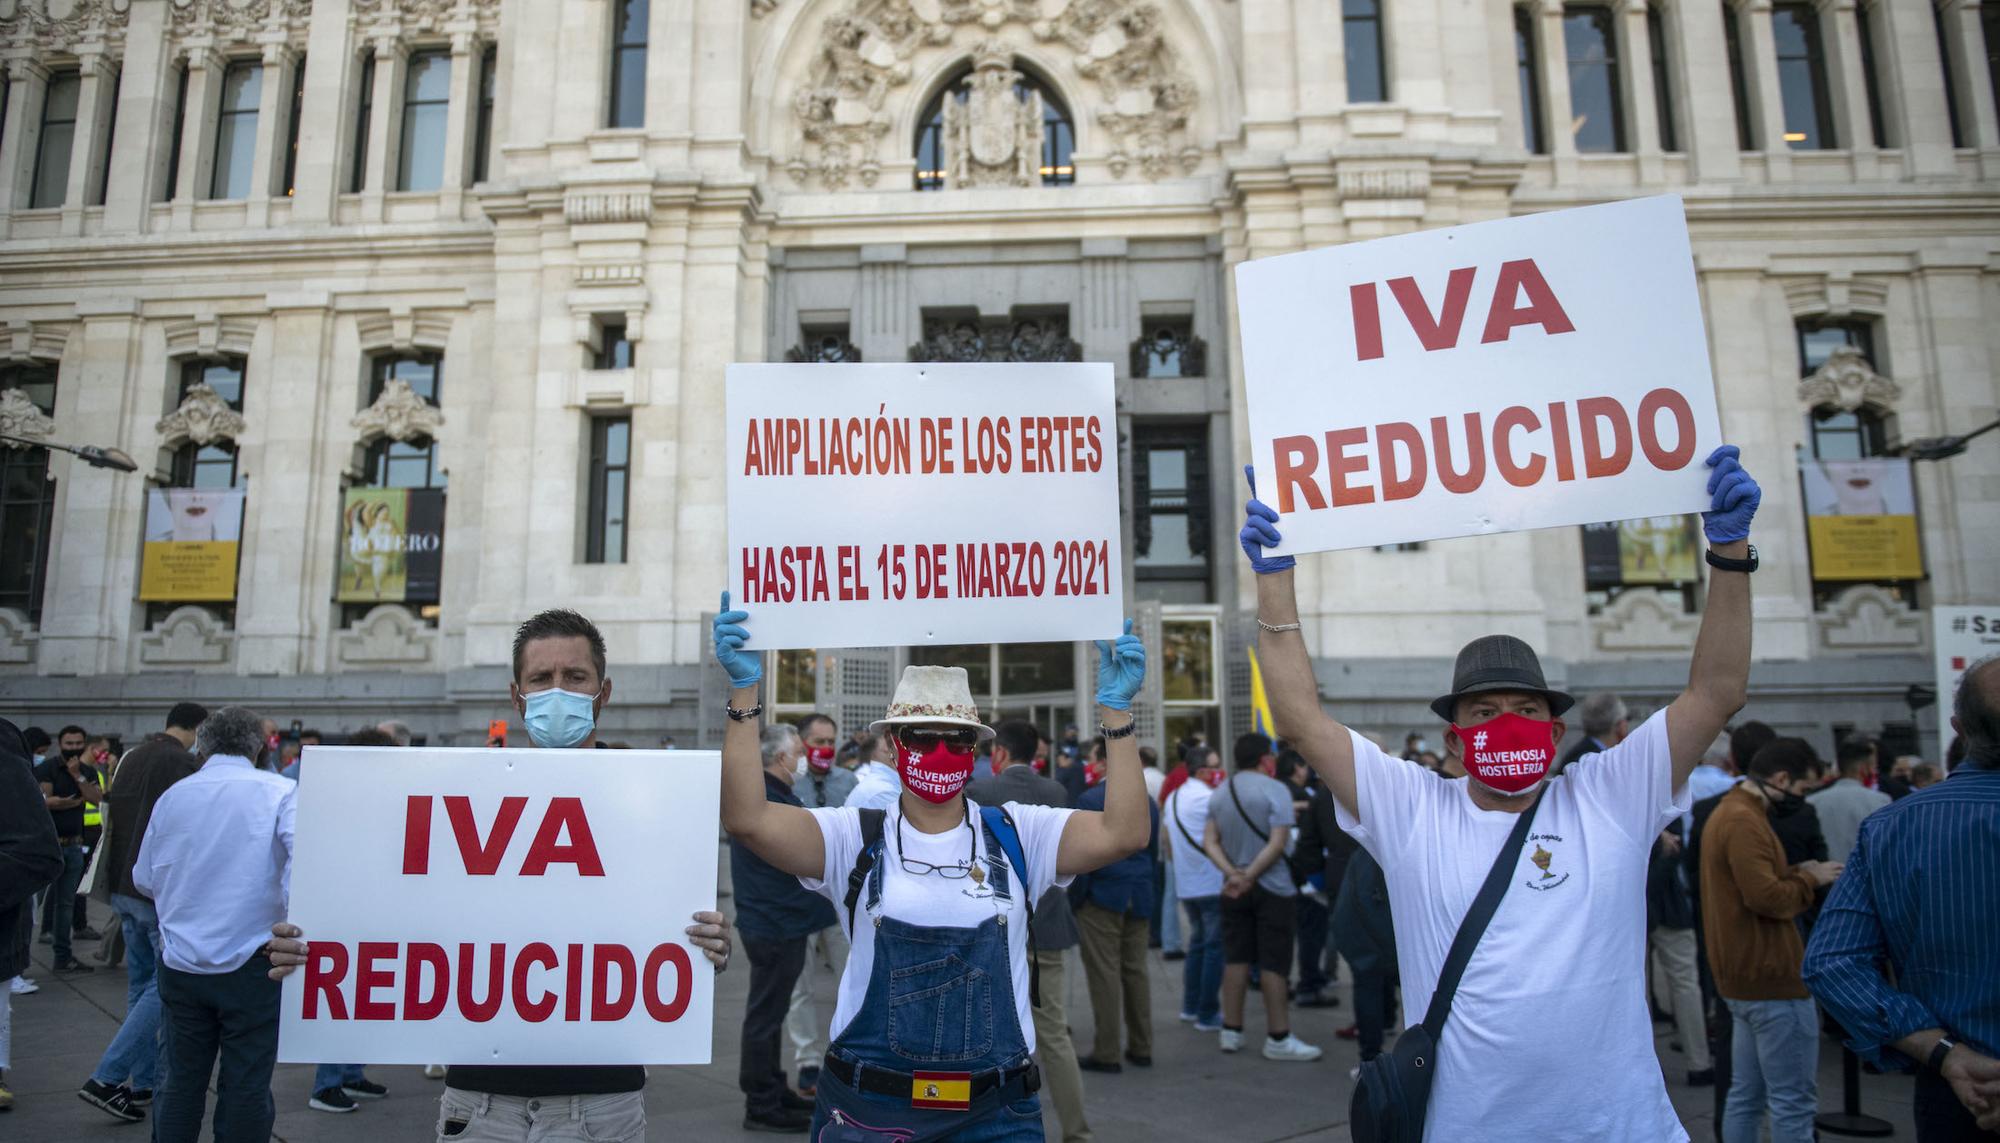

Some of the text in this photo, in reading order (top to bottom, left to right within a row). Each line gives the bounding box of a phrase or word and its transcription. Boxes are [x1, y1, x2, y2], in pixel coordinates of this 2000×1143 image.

[1349, 257, 1576, 361] IVA
[744, 402, 1102, 476] AMPLIACIÓN DE LOS ERTES
[1273, 388, 1695, 514] REDUCIDO
[743, 541, 1109, 603] HASTA EL 15 DE MARZO 2021
[1473, 731, 1488, 750] #
[402, 795, 605, 878] IVA
[302, 941, 693, 1022] REDUCIDO
